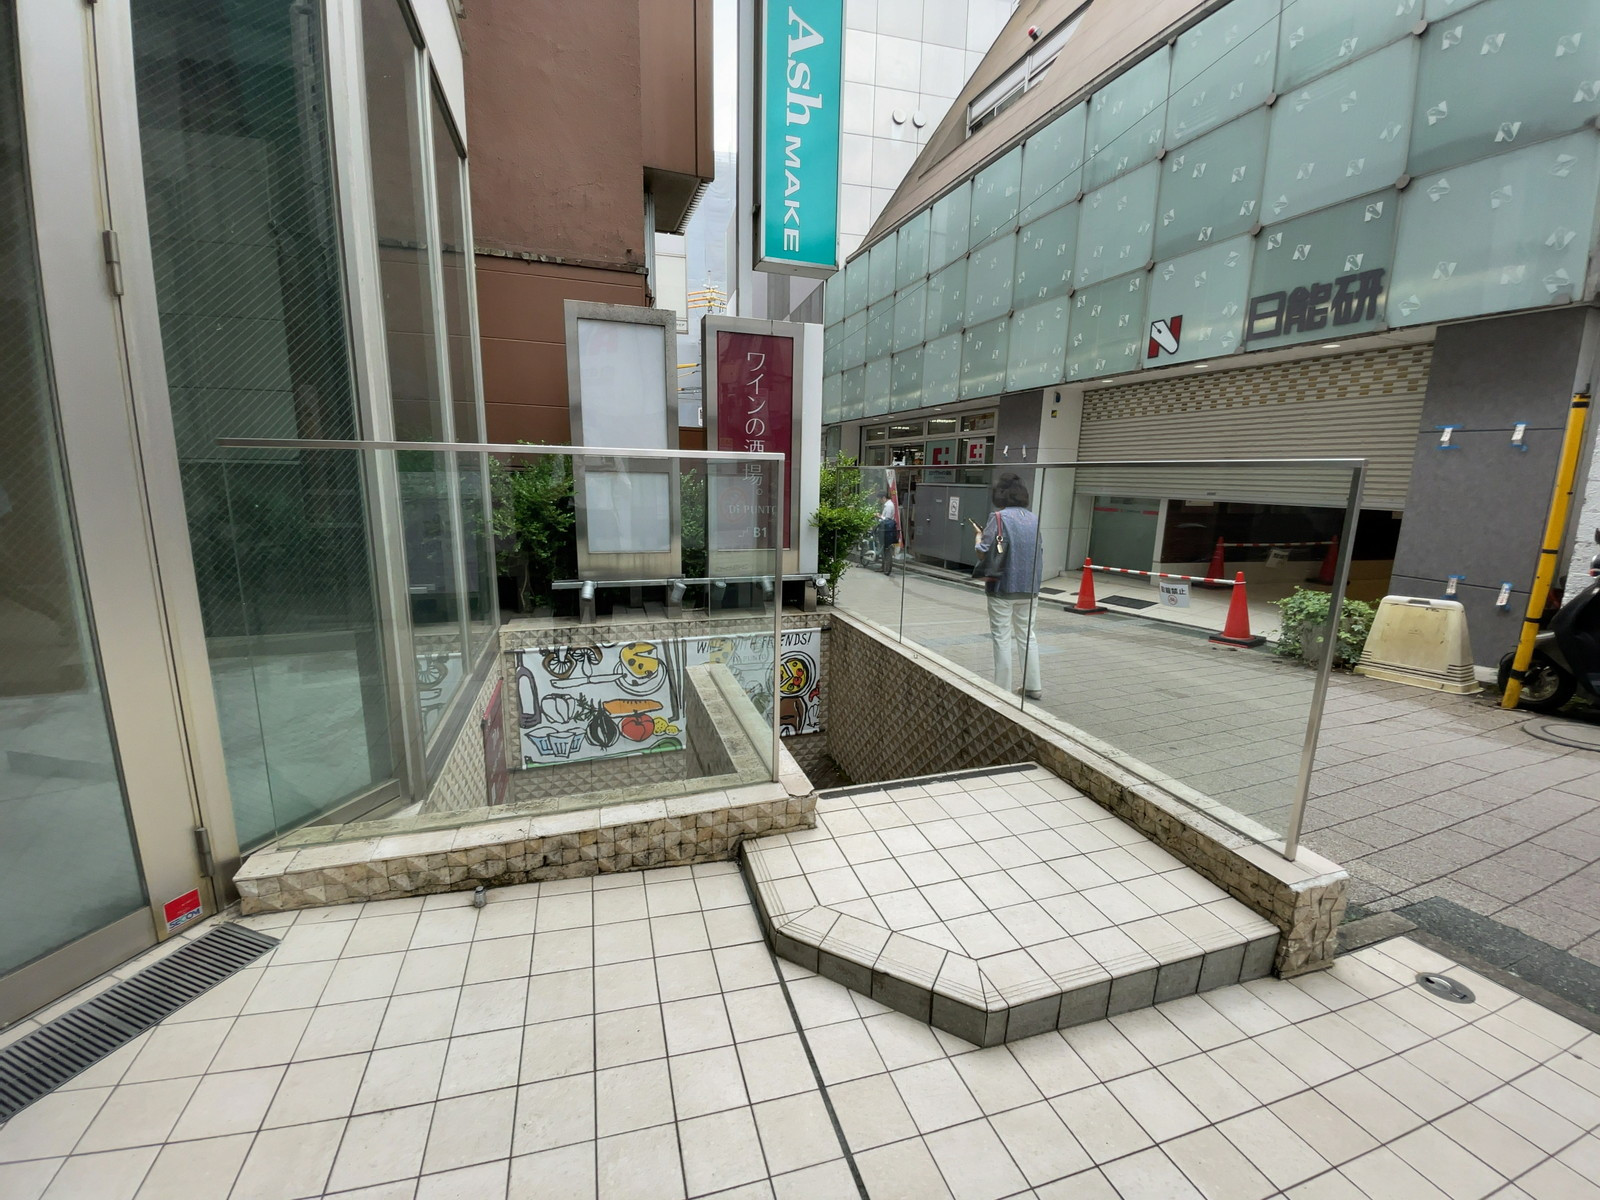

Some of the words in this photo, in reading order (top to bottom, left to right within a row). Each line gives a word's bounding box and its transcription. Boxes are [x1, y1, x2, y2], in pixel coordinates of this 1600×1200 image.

[786, 6, 824, 127] Ash
[783, 135, 801, 252] MAKE
[1246, 268, 1385, 342] 日能研
[753, 527, 767, 538] B1
[761, 632, 812, 649] FRENDS!
